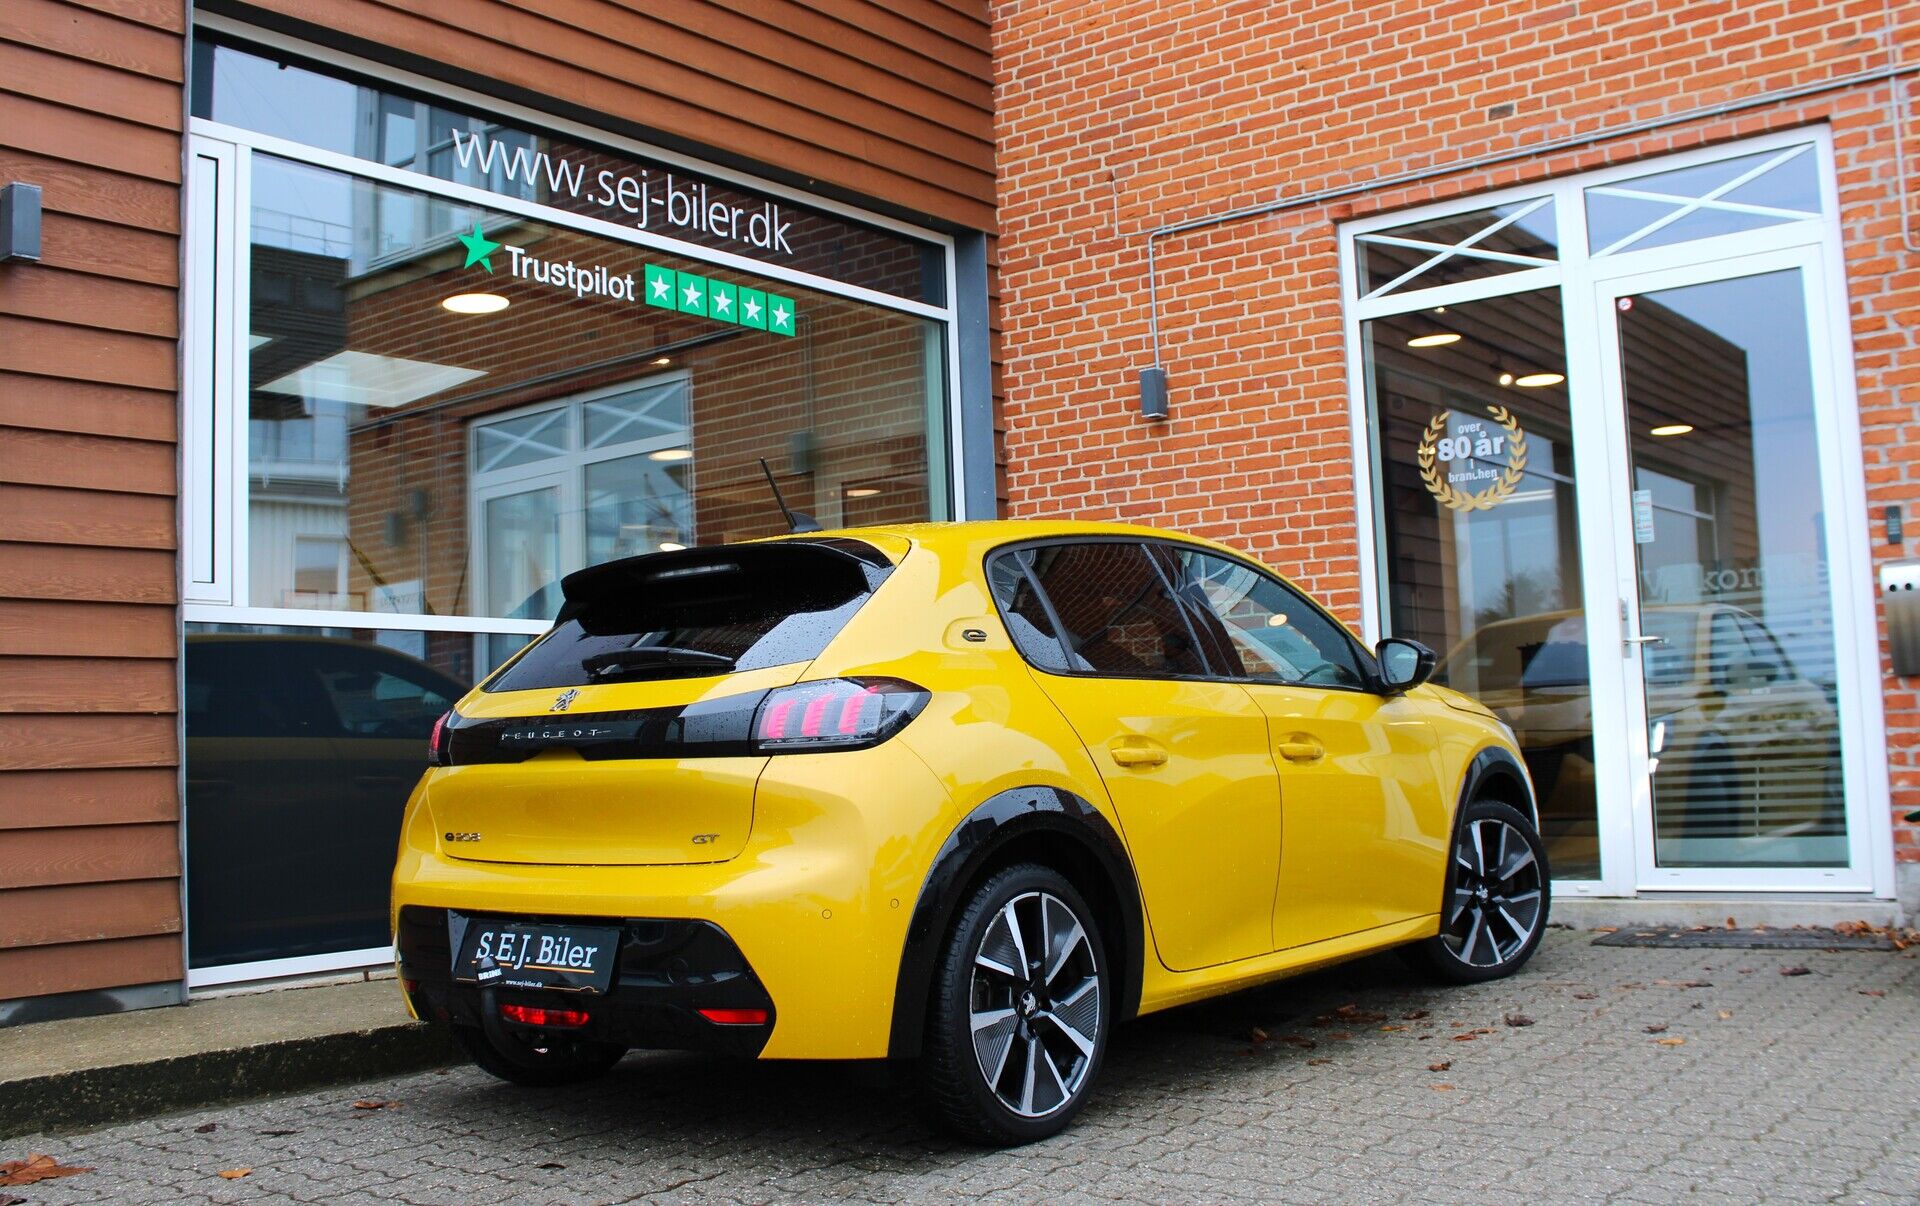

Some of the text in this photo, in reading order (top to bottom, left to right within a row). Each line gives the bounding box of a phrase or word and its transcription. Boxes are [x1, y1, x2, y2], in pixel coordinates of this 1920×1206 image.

[452, 127, 793, 255] www.sej-biler.dk
[504, 244, 635, 301] Trustpilot
[1458, 422, 1482, 434] over
[1437, 430, 1505, 461] 80 år
[501, 729, 599, 741] PEUGEOT
[692, 834, 720, 844] GT
[536, 935, 597, 968] Biler
[477, 968, 502, 981] BRINK
